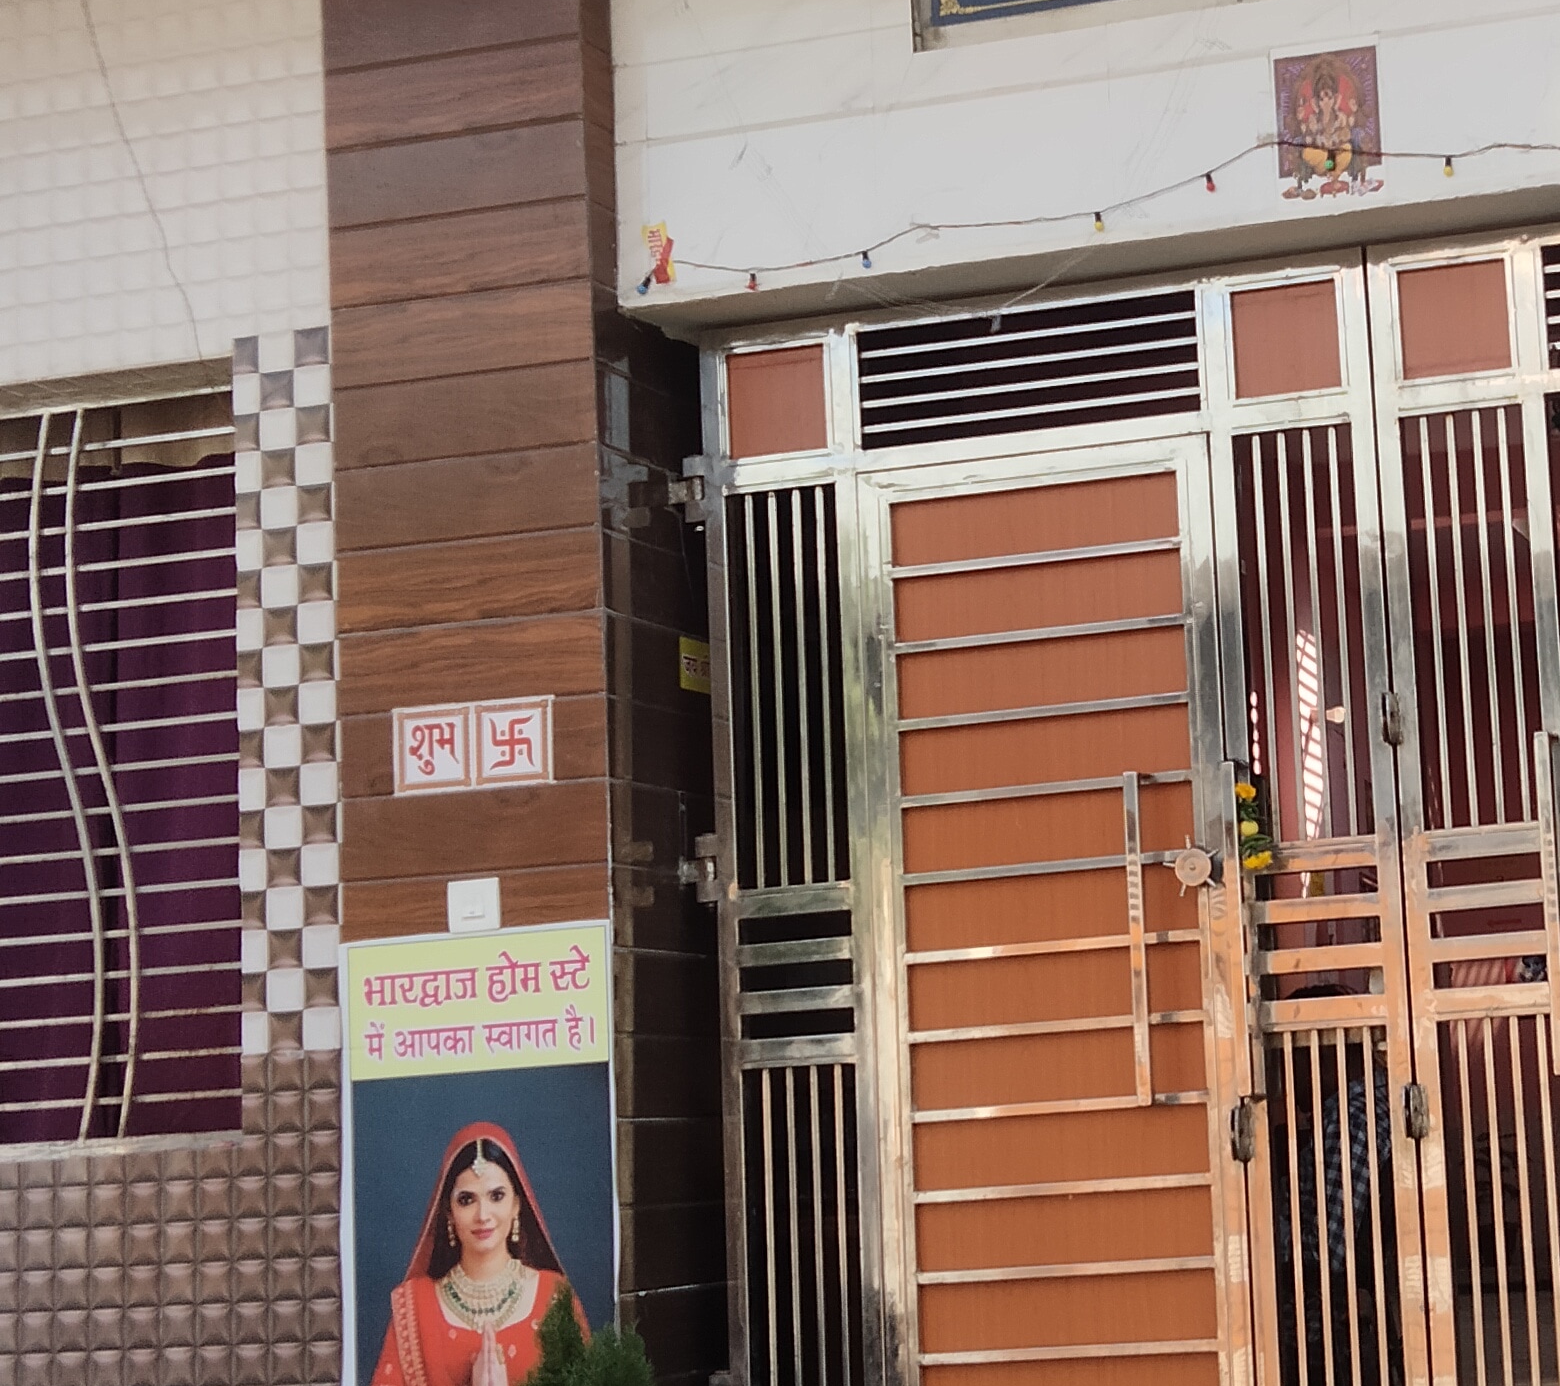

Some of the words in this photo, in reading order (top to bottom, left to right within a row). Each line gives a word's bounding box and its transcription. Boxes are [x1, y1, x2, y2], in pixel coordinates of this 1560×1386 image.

[408, 720, 460, 776] शुभ
[363, 966, 479, 1008] भारद्वाज
[485, 950, 542, 1003] होम
[548, 944, 590, 991] स्टे
[363, 1021, 385, 1061] में
[393, 1025, 475, 1058] आपका
[481, 1018, 558, 1054] स्वागत
